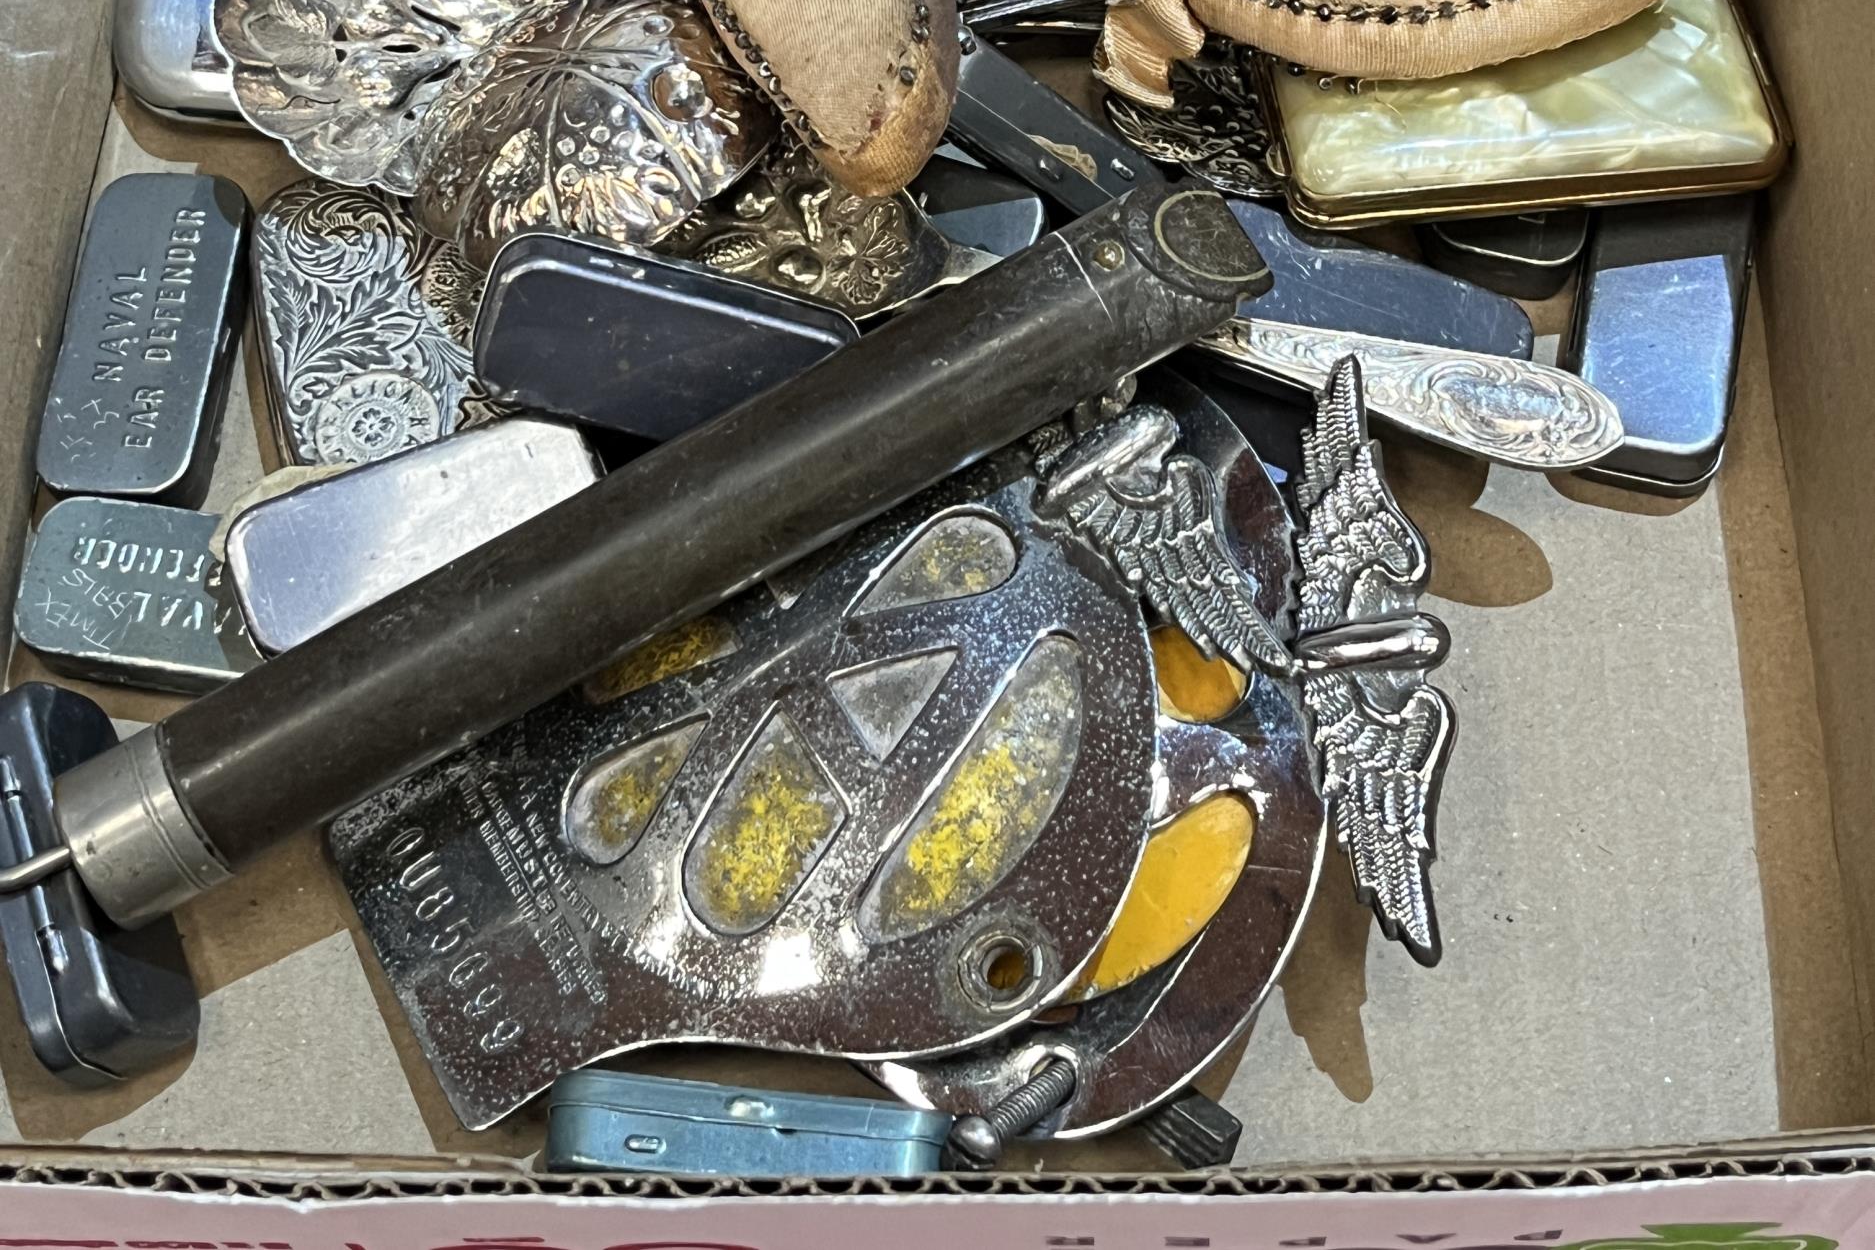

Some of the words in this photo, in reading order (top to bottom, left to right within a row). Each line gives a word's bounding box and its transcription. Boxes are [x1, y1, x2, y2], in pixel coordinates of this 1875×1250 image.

[142, 208, 206, 362] DEFENDER
[92, 267, 148, 382] NAVAL
[122, 388, 165, 448] EAR
[73, 536, 223, 587] EFENDER
[133, 591, 247, 636] AVAL
[506, 826, 549, 888] MUST
